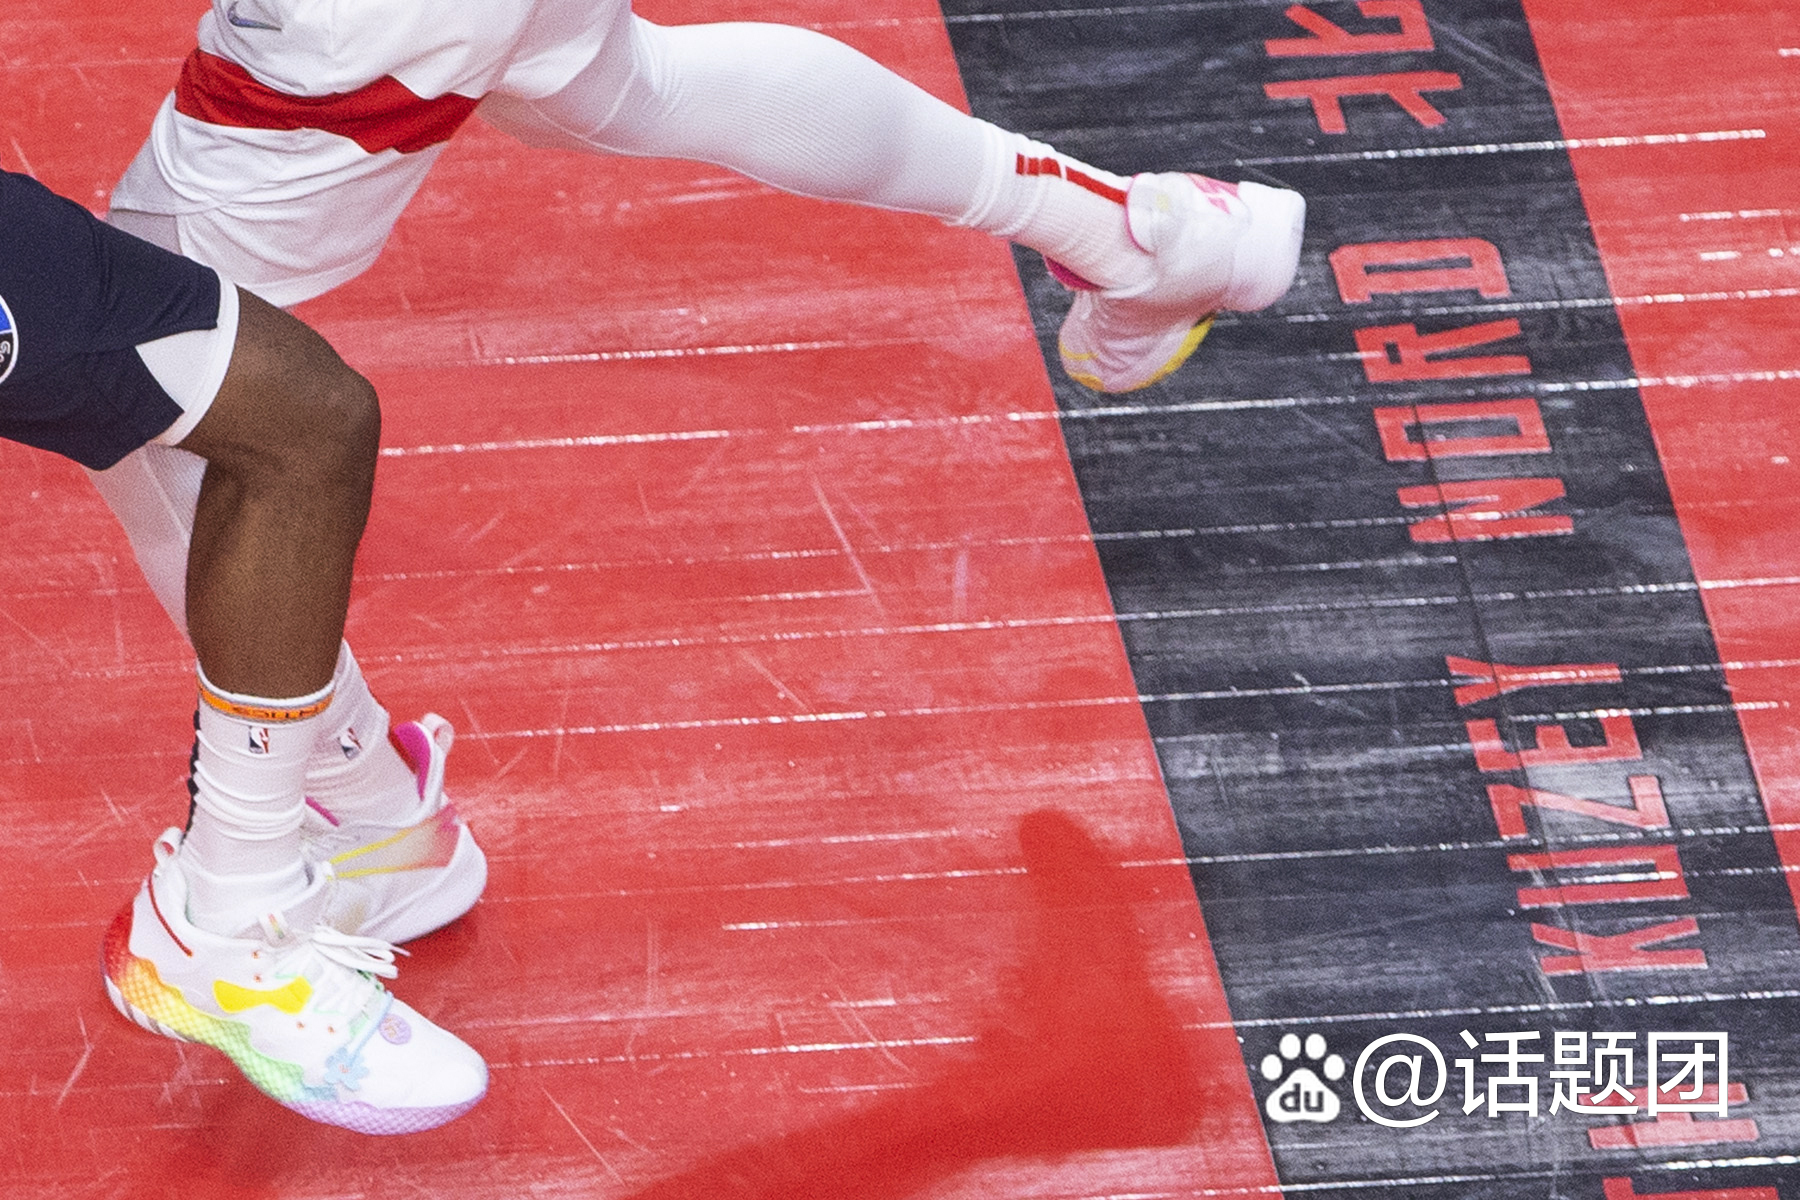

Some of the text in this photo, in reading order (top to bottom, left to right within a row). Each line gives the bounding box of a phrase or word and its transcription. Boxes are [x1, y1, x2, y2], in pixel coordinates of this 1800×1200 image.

[1262, 0, 1463, 134] 北
[1330, 238, 1574, 542] NORD
[1446, 655, 1708, 976] KUZEY
